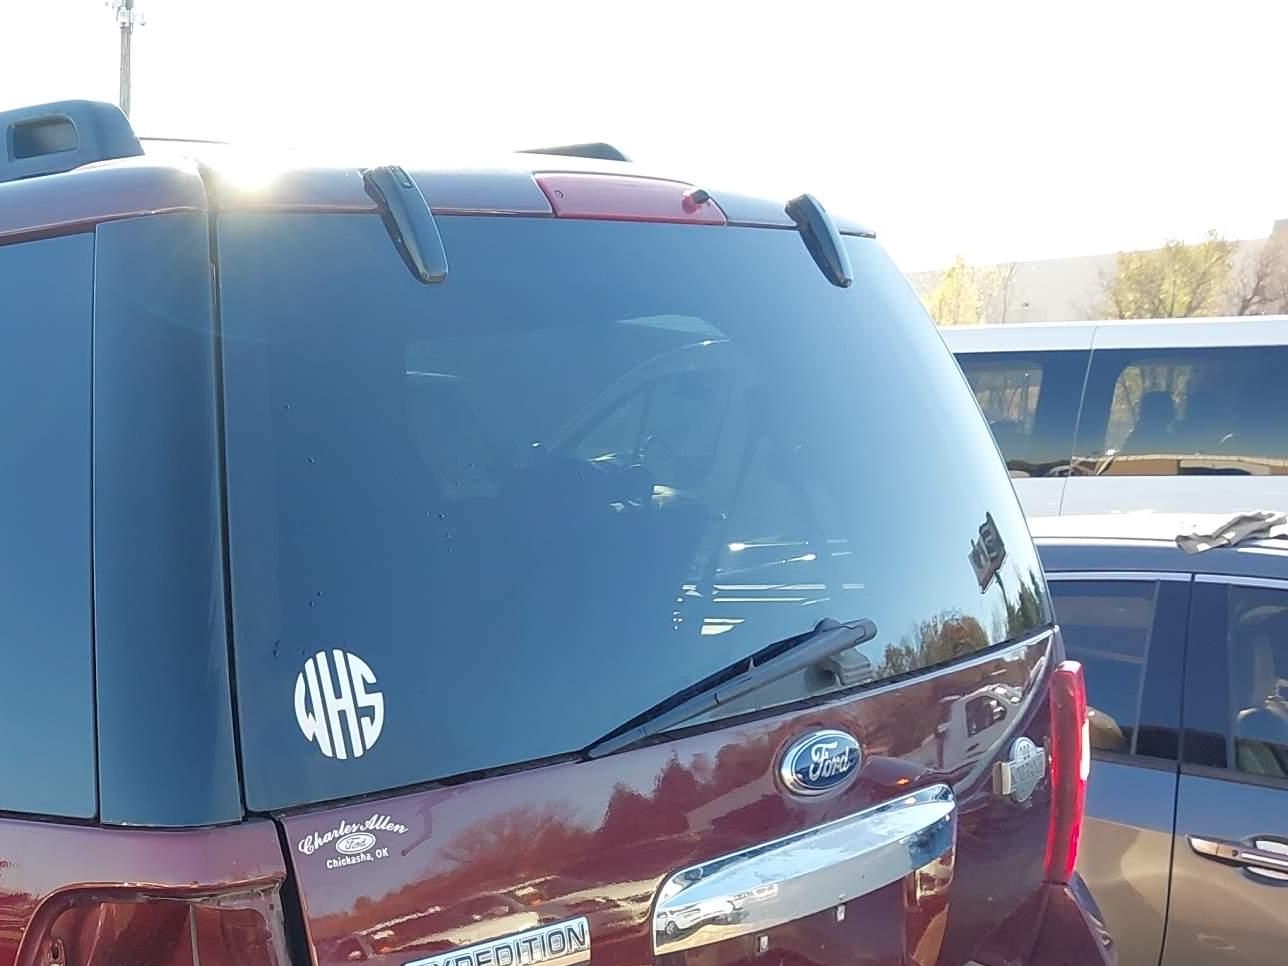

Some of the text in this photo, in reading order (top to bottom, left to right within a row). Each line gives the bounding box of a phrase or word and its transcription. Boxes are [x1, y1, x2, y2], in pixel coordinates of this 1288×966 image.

[294, 649, 385, 760] WHS
[809, 741, 852, 781] Ford
[298, 814, 408, 854] Charles Allen
[375, 848, 389, 858] OK
